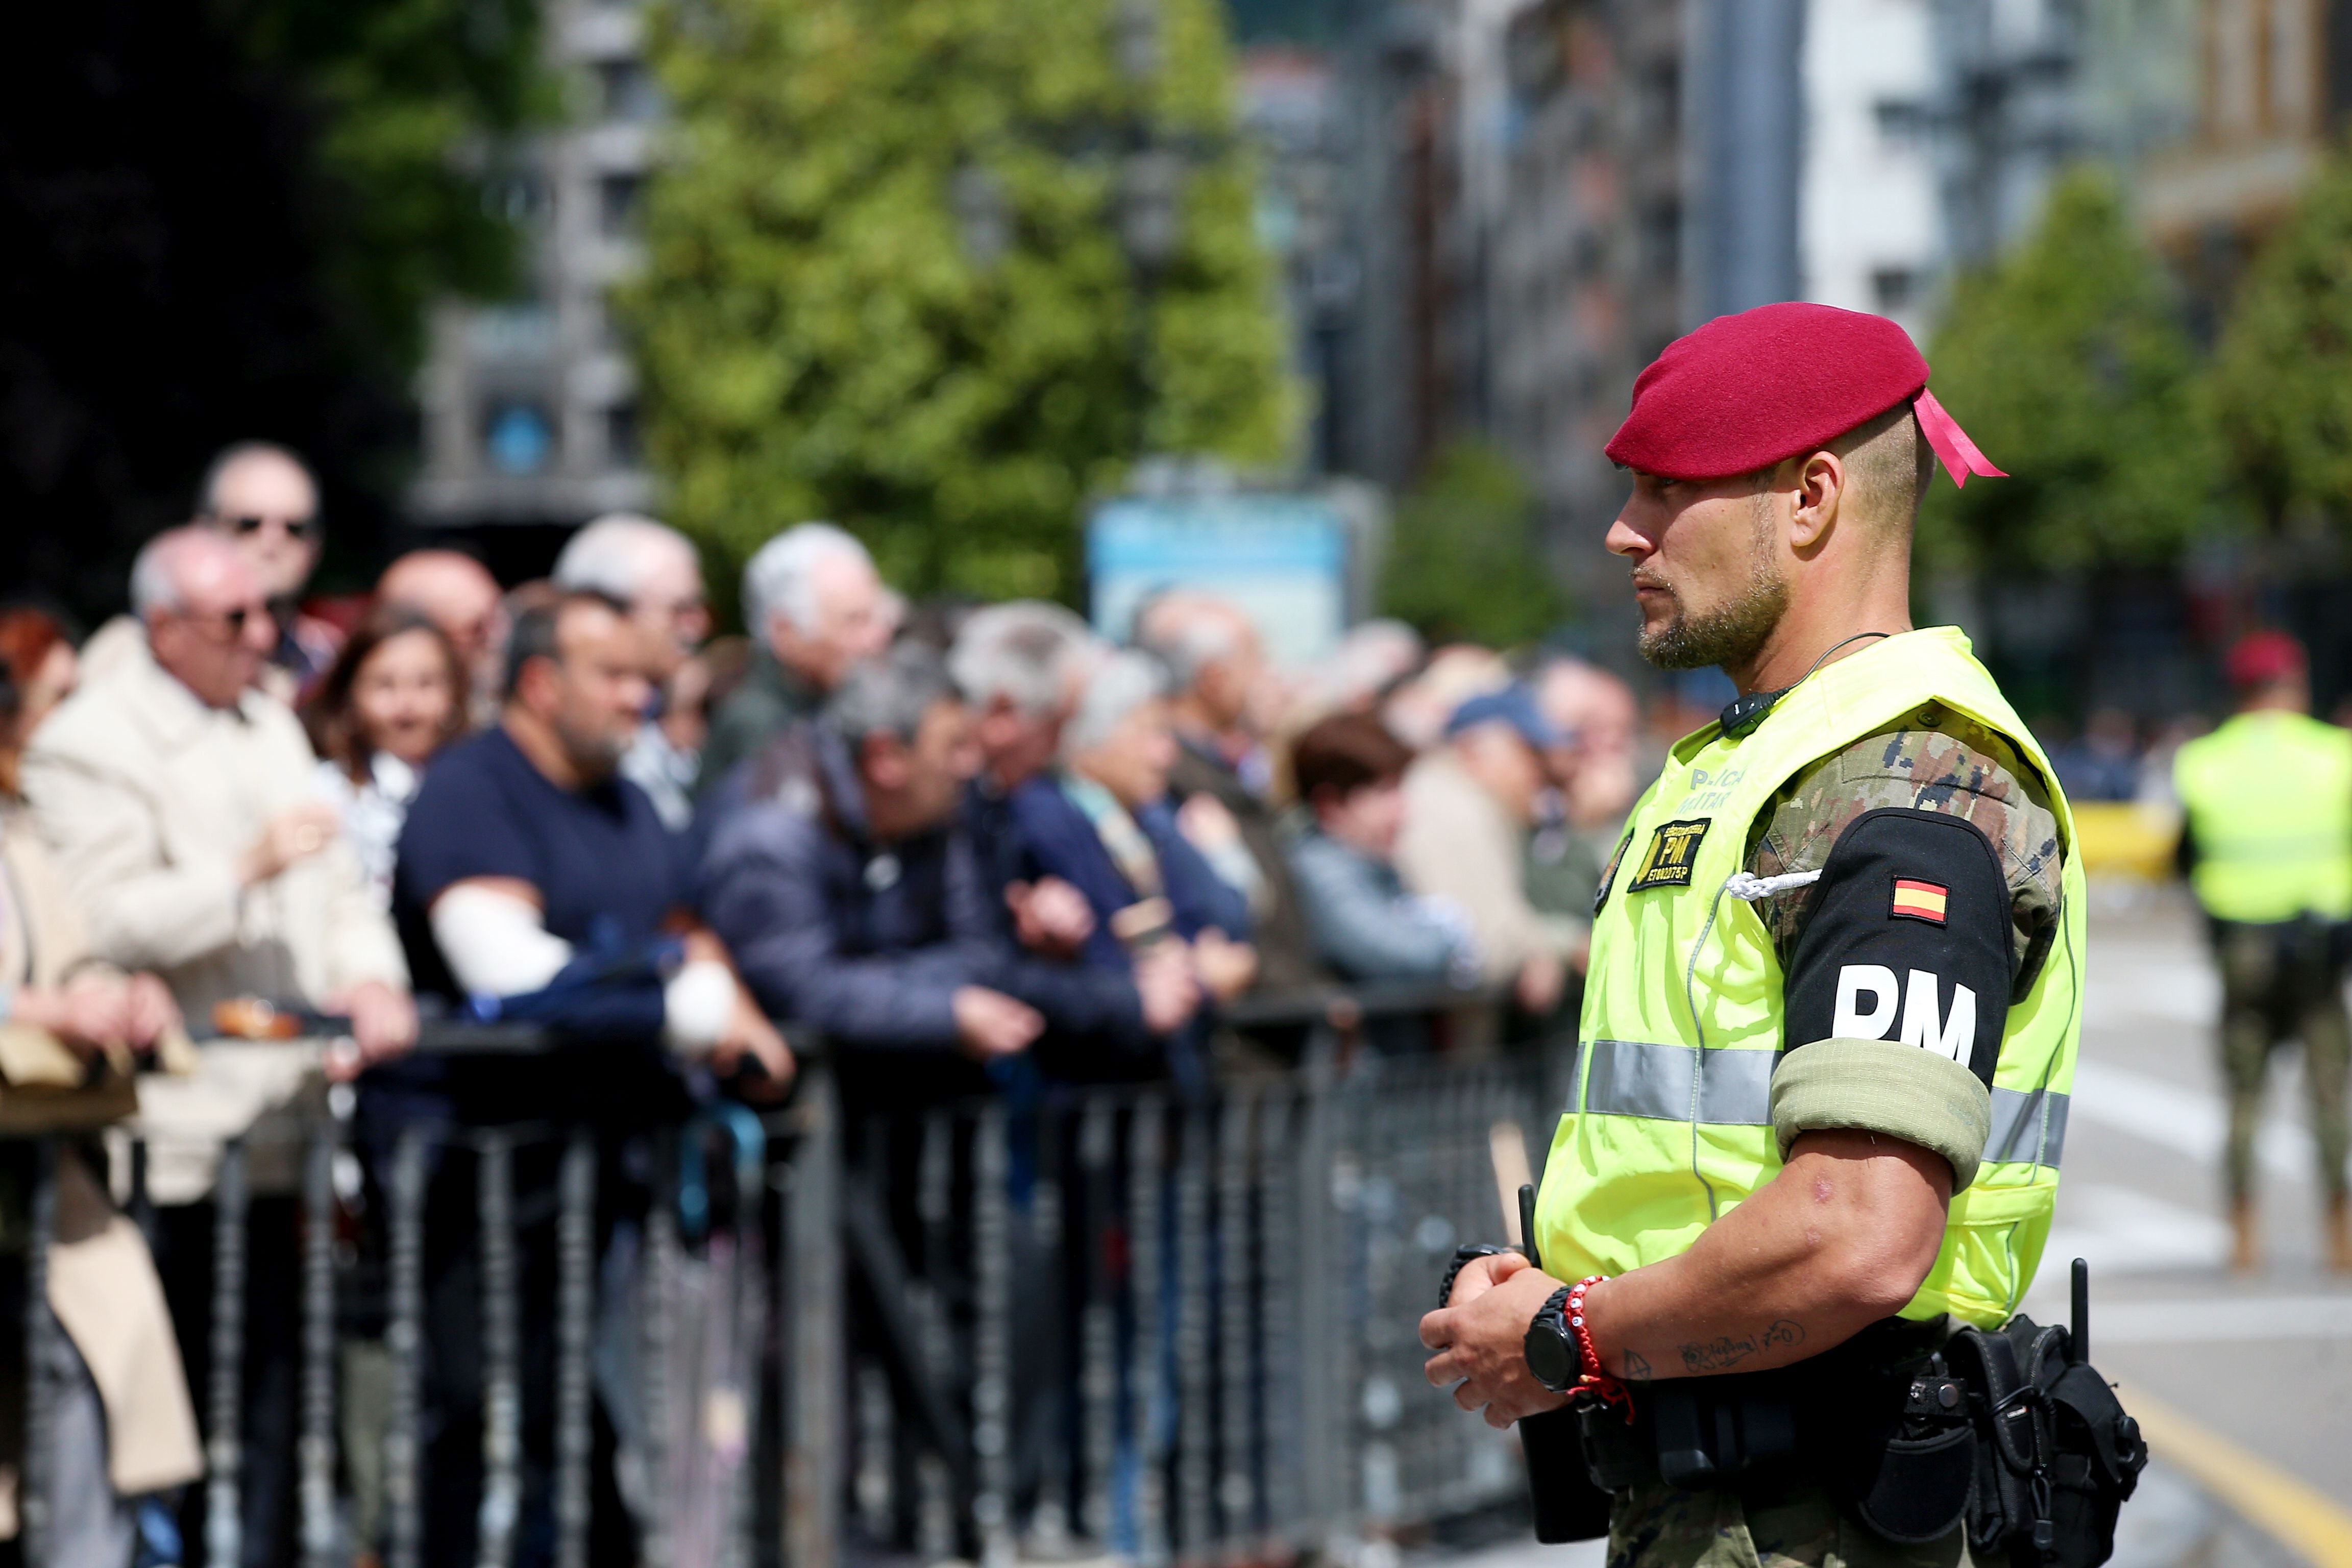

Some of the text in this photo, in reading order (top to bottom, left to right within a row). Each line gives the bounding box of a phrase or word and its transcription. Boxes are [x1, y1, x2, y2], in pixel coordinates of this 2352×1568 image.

[1676, 791, 1732, 814] MLITAR
[1658, 835, 1691, 866] PM
[1831, 964, 1976, 1068] PM
